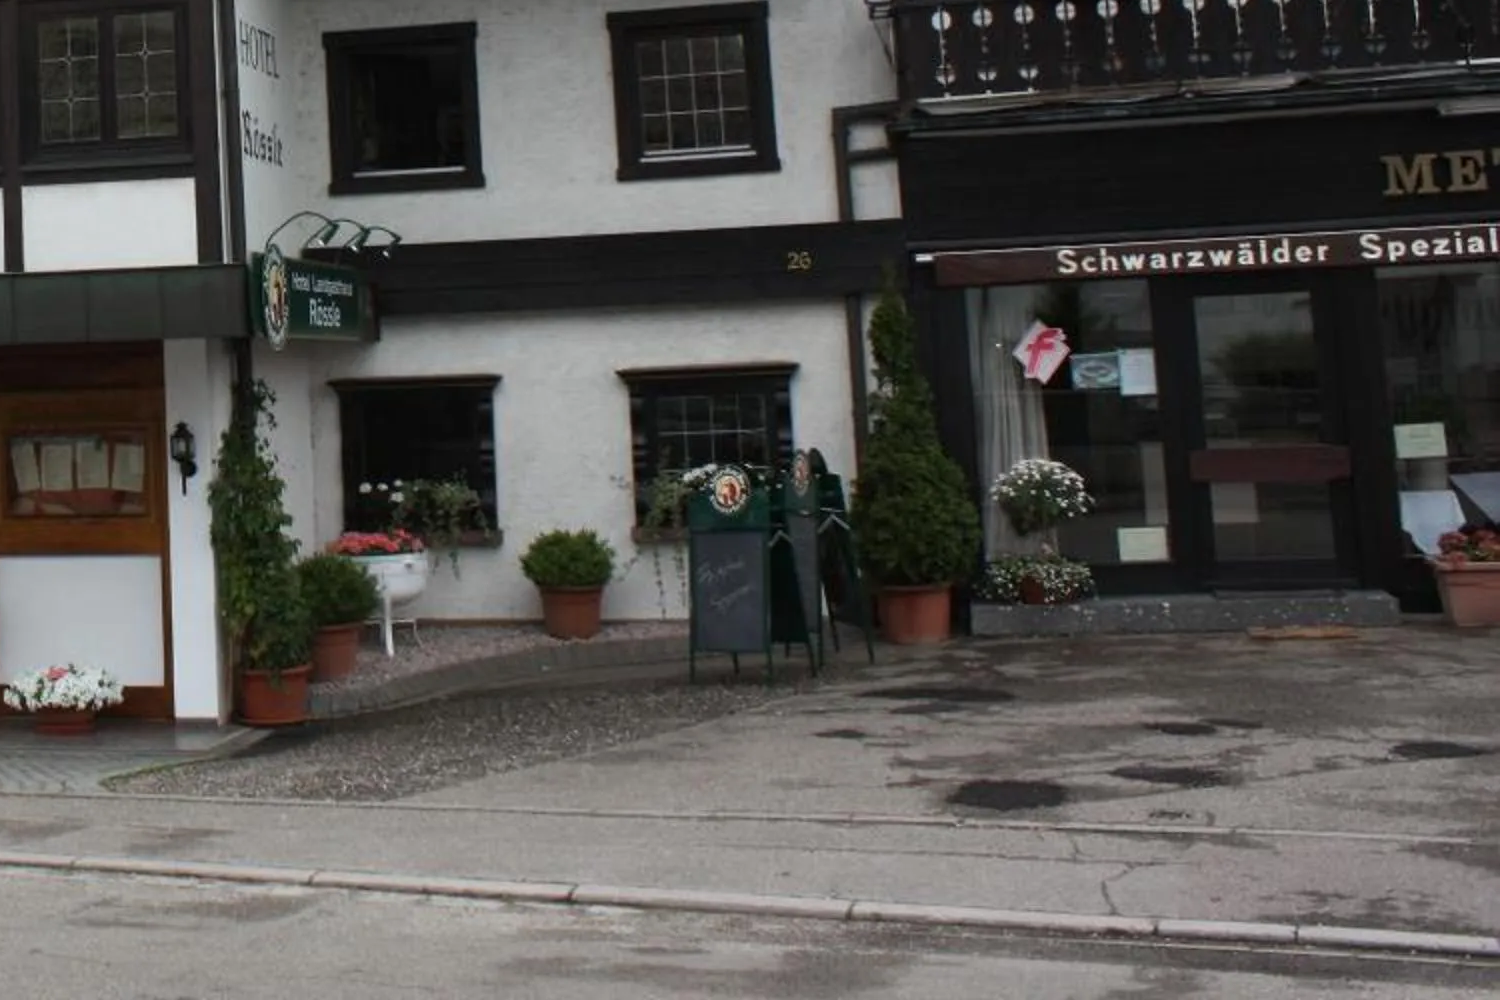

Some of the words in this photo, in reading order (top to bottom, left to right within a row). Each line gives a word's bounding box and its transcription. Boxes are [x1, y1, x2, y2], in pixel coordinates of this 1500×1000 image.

[239, 20, 280, 78] HOTEL
[1380, 148, 1500, 196] ME
[1057, 238, 1329, 273] Schwarzwälder
[1359, 227, 1499, 262] Spezial
